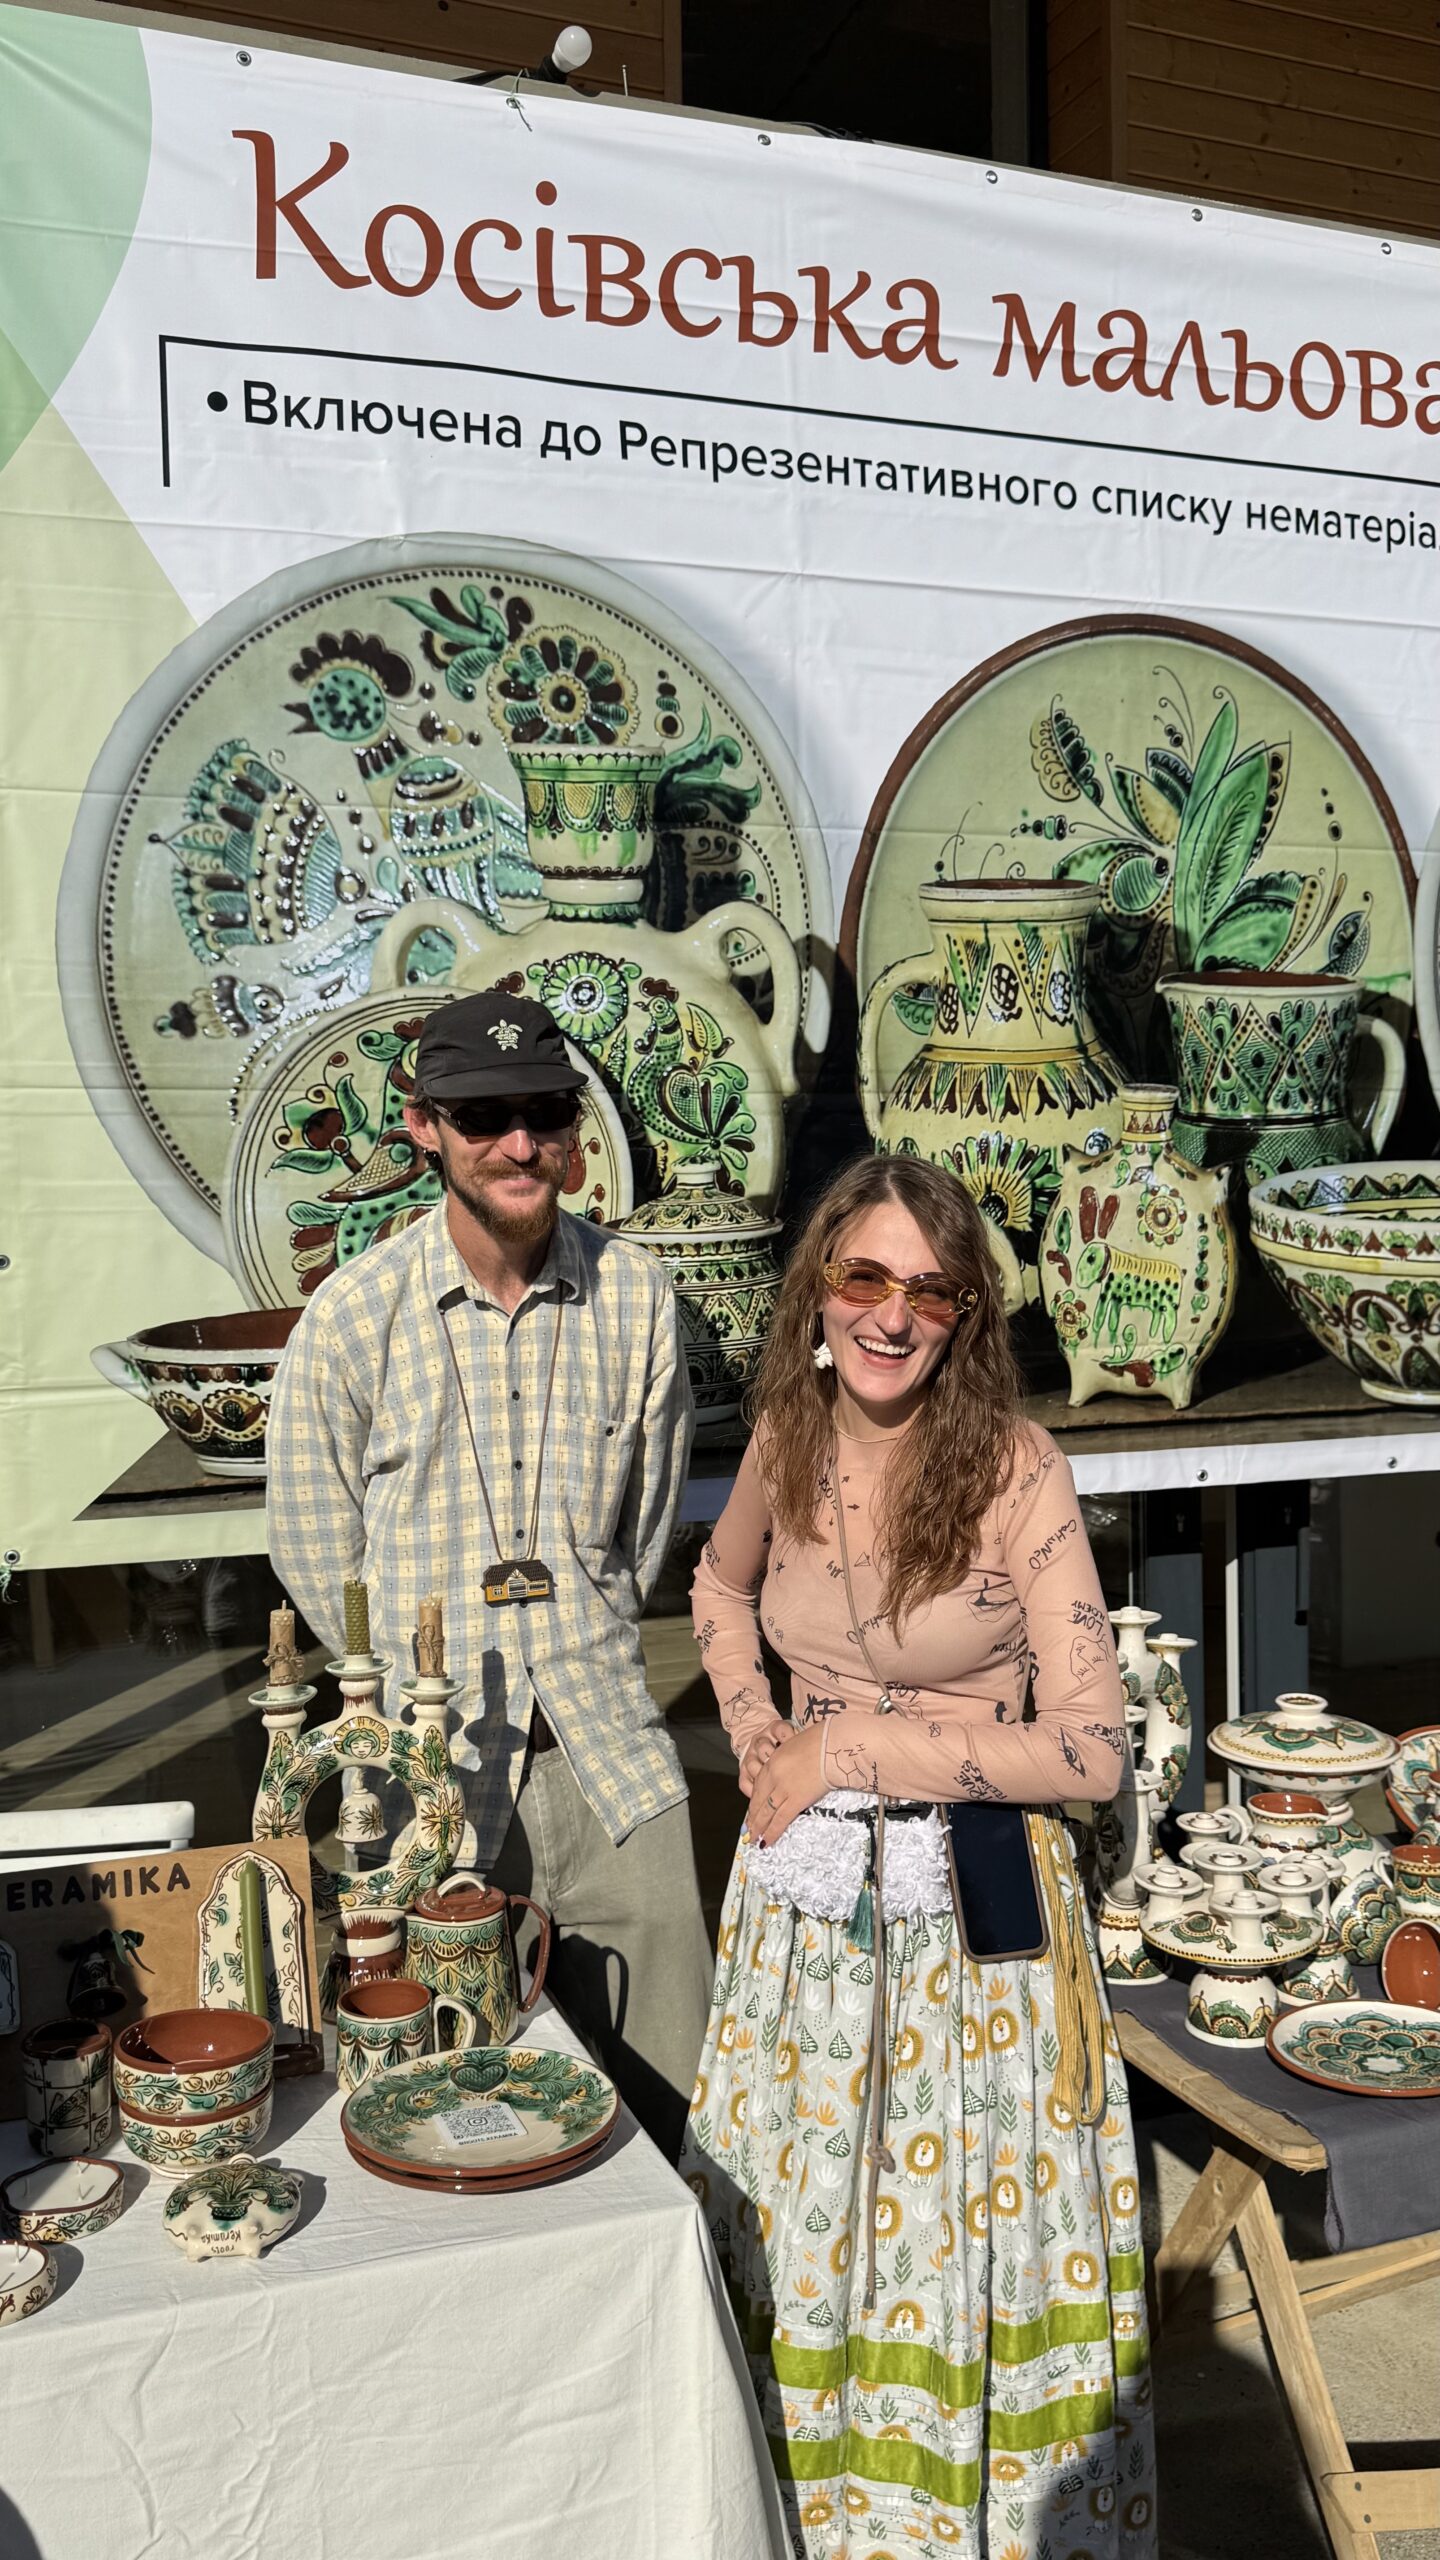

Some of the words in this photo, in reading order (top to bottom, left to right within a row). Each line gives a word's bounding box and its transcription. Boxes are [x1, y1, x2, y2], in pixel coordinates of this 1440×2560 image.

[232, 130, 958, 370] Косівська
[243, 379, 522, 448] Включена
[540, 420, 602, 461] до
[619, 420, 1077, 510] Репрезентативного
[1092, 485, 1233, 536] списку
[1246, 502, 1440, 554] нематеріа
[6, 1862, 191, 1912] ERAMIKA
